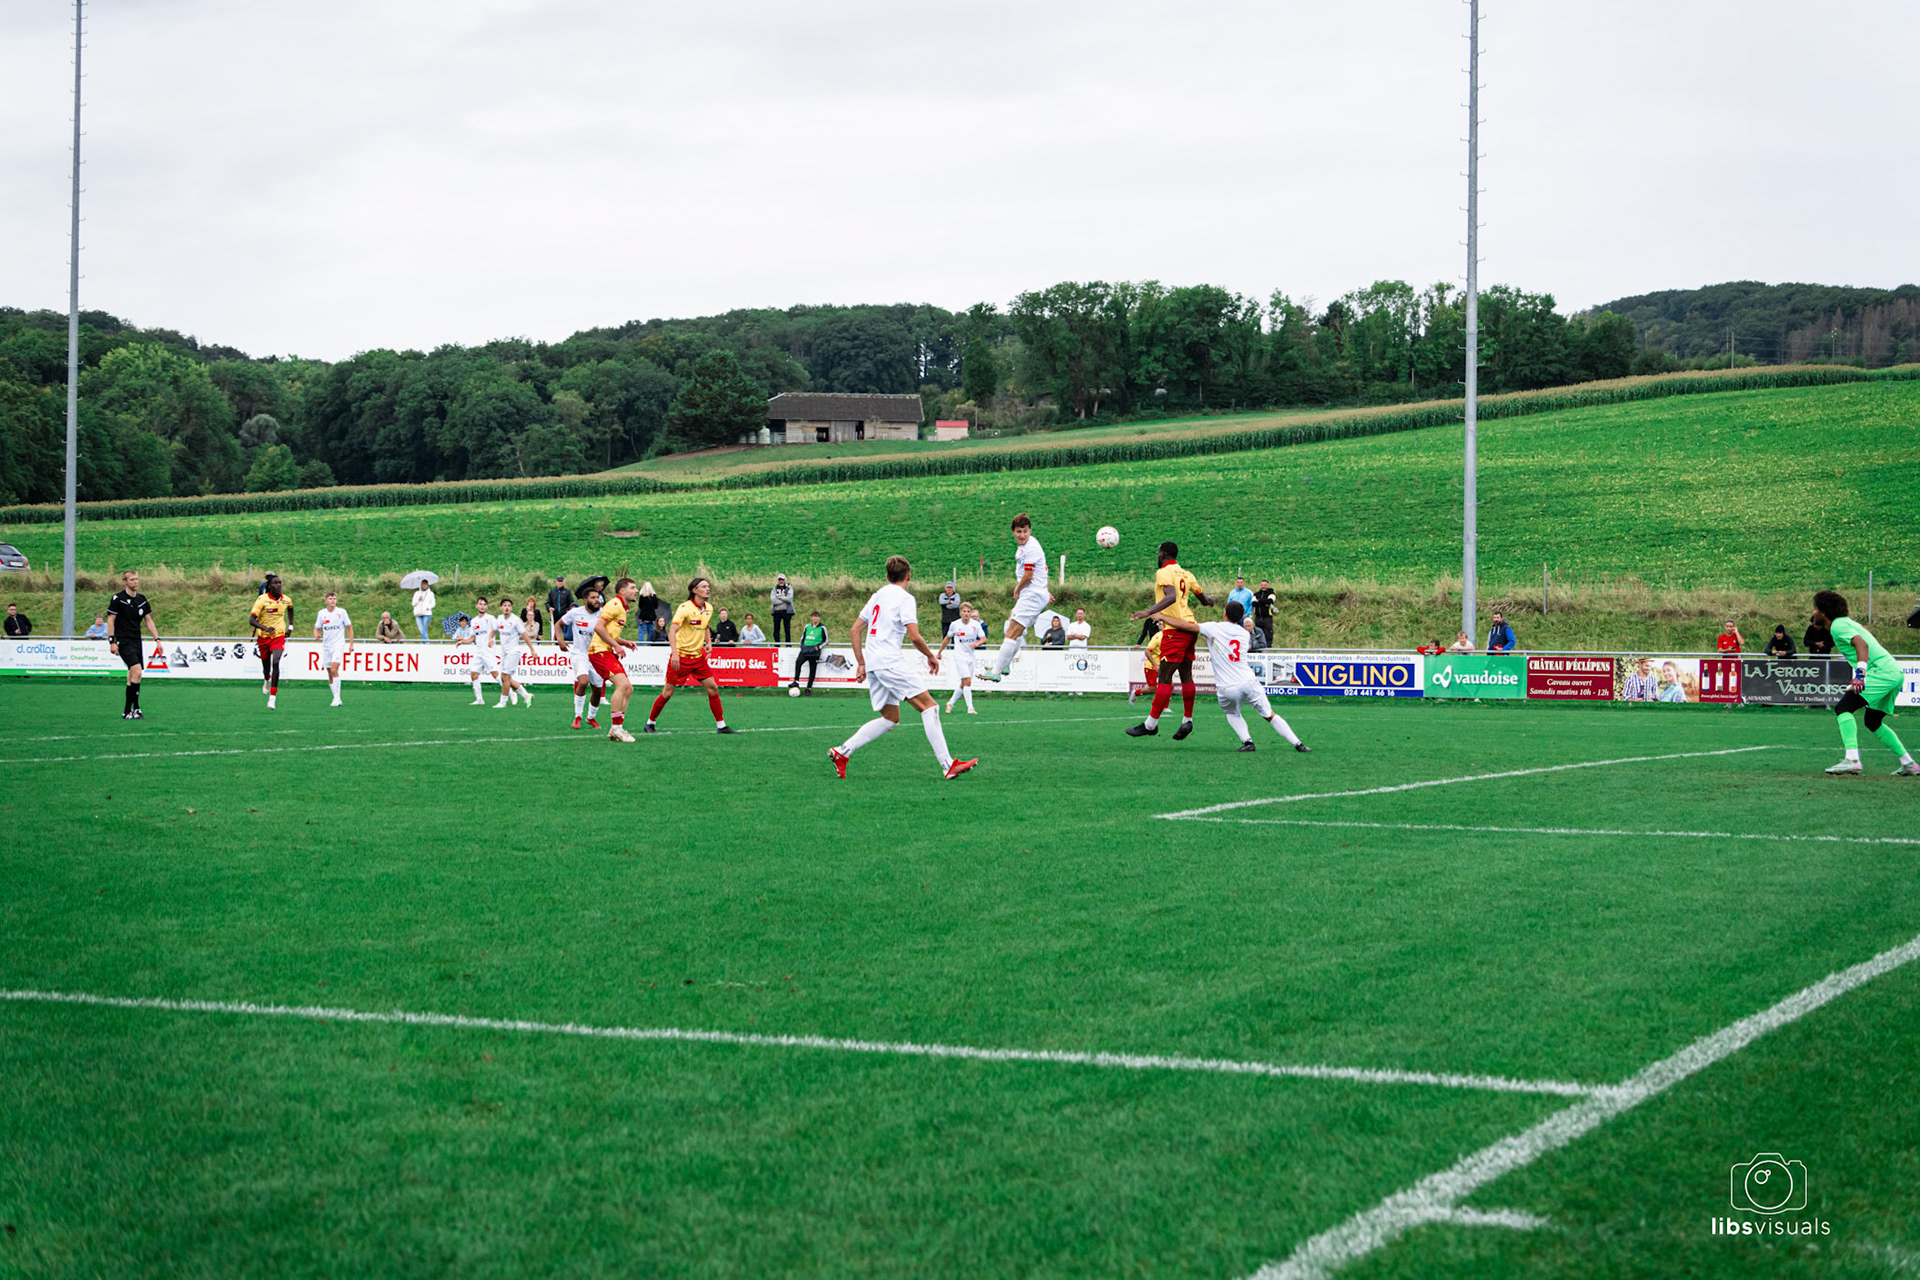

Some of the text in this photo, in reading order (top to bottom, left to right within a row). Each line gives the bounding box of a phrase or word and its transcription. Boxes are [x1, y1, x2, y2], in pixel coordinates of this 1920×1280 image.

[1180, 578, 1186, 599] 9
[1064, 652, 1099, 661] pressing
[1228, 639, 1241, 662] 3
[308, 651, 419, 672] RFFEISEN
[1529, 658, 1611, 672] CHÂTEAU D'ÉCLÉPENS
[443, 667, 456, 675] au
[517, 668, 527, 676] la
[529, 667, 568, 677] beauté
[628, 664, 660, 674] MARCHON
[1301, 664, 1409, 687] VIGLINO
[1454, 670, 1519, 686] vaudoise
[1546, 678, 1571, 686] Caveau
[1529, 687, 1556, 696] Samedis
[1556, 688, 1578, 696] matins
[1579, 688, 1592, 696] 10h
